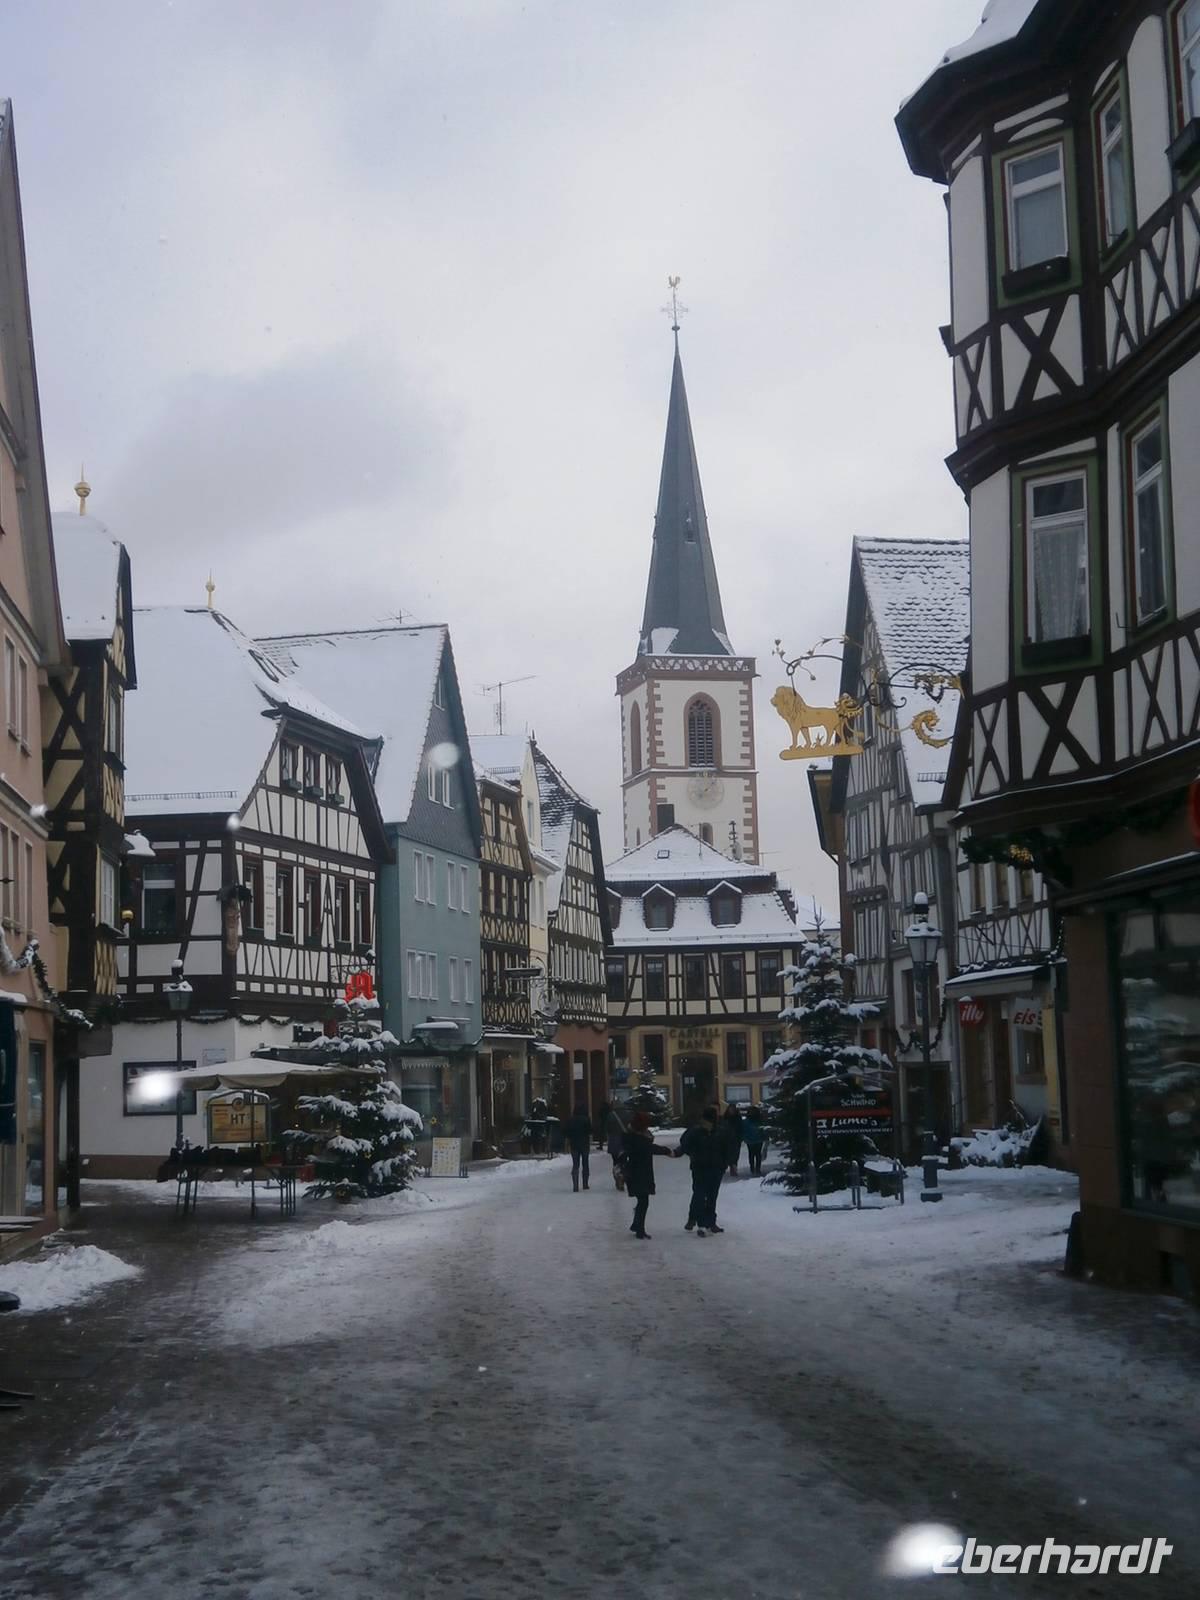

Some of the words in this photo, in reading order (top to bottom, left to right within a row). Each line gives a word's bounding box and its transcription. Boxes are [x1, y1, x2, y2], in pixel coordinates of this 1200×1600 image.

[961, 1004, 985, 1024] illy
[669, 1027, 721, 1039] CASTELL
[678, 1039, 713, 1050] BANK
